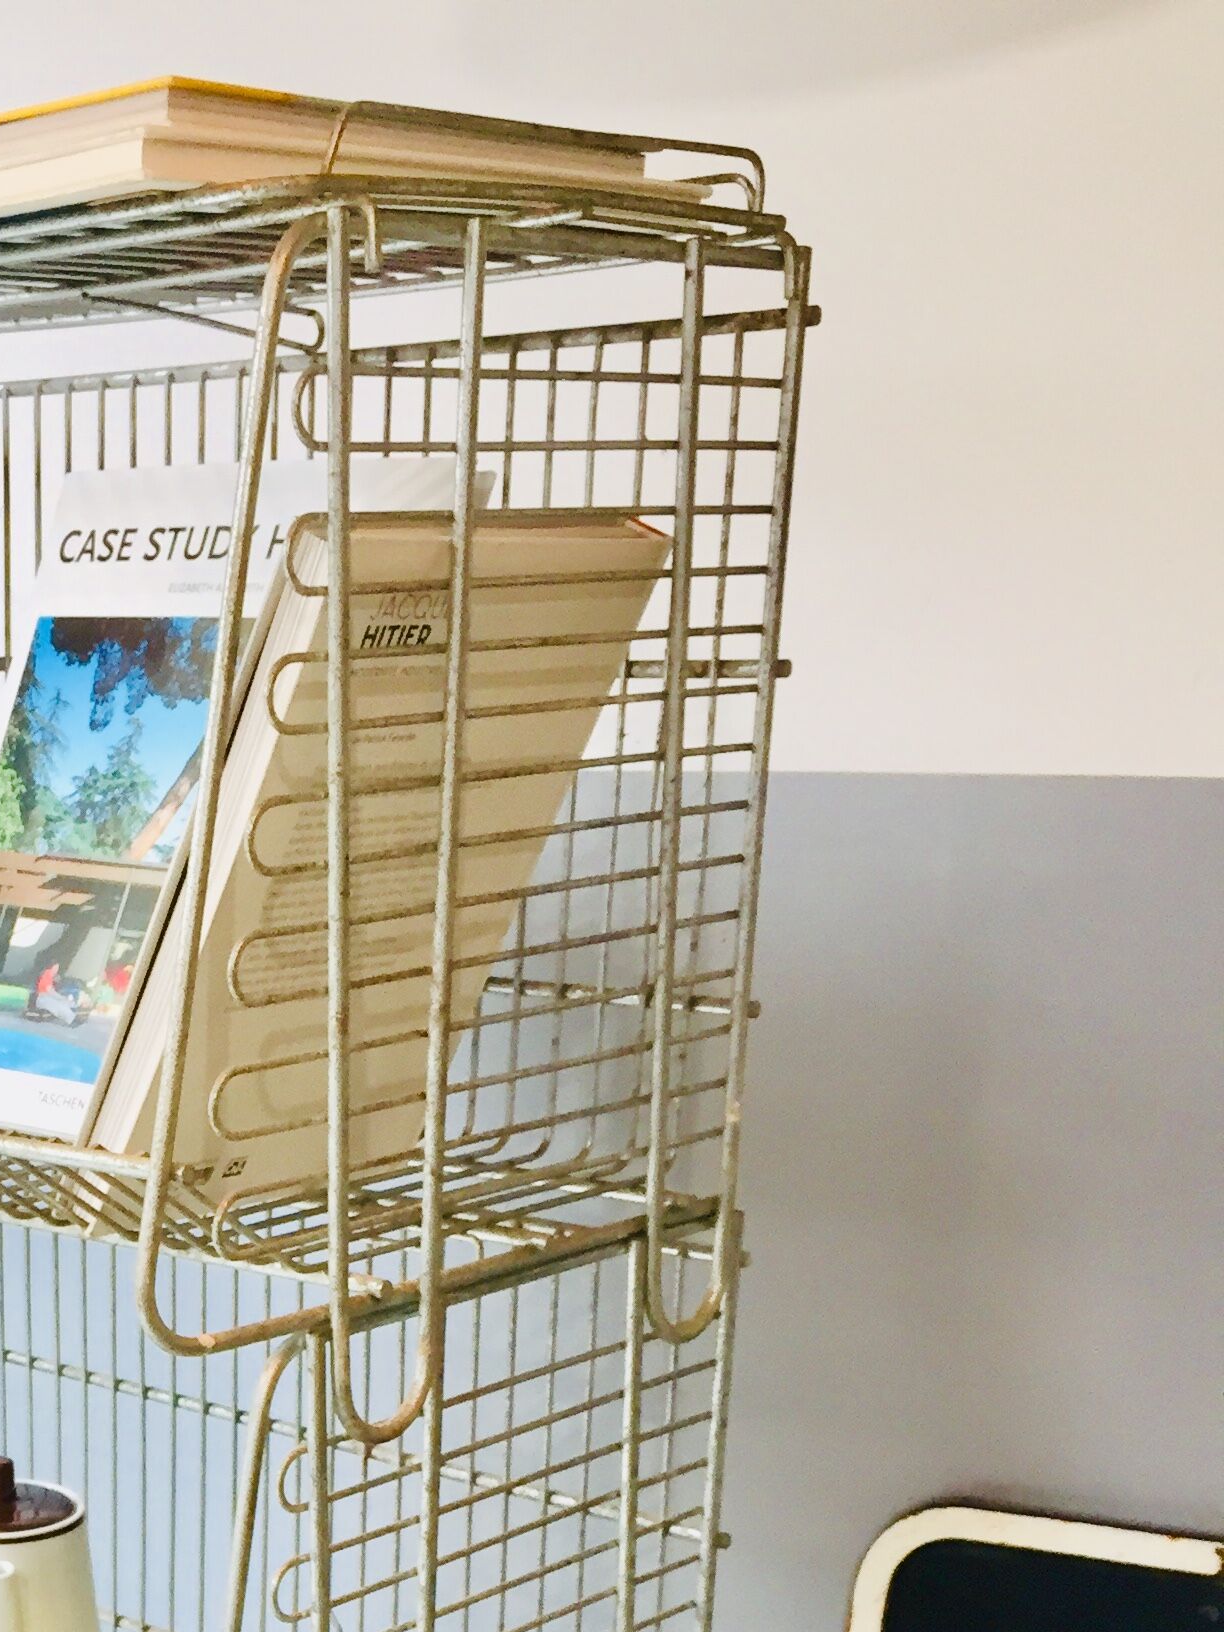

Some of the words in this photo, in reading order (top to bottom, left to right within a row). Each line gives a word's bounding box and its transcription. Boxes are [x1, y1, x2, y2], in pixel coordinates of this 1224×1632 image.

[59, 527, 138, 564] CASE
[143, 525, 260, 562] STUD
[370, 593, 449, 621] JACQU
[360, 623, 432, 650] HITIER
